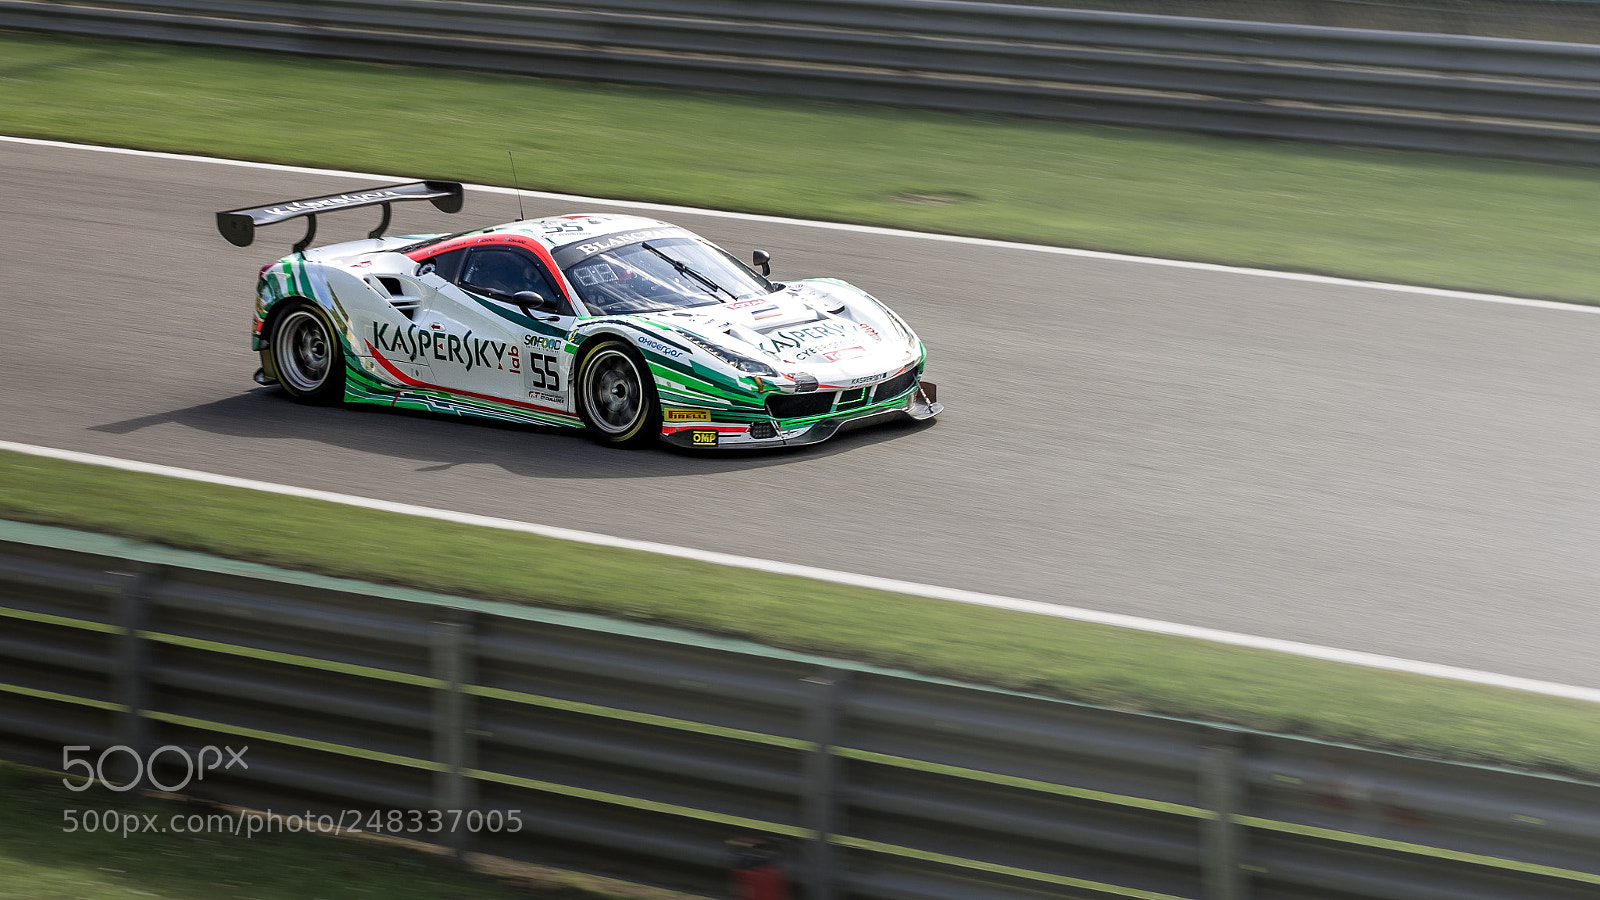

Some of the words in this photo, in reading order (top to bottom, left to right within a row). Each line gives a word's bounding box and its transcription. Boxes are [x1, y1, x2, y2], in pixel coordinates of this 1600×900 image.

[575, 229, 678, 256] BLANCPA
[373, 321, 506, 372] KASPERSKY
[507, 345, 521, 374] lab
[530, 352, 560, 391] 55
[668, 410, 707, 420] PIRELLI
[693, 433, 717, 443] OMP
